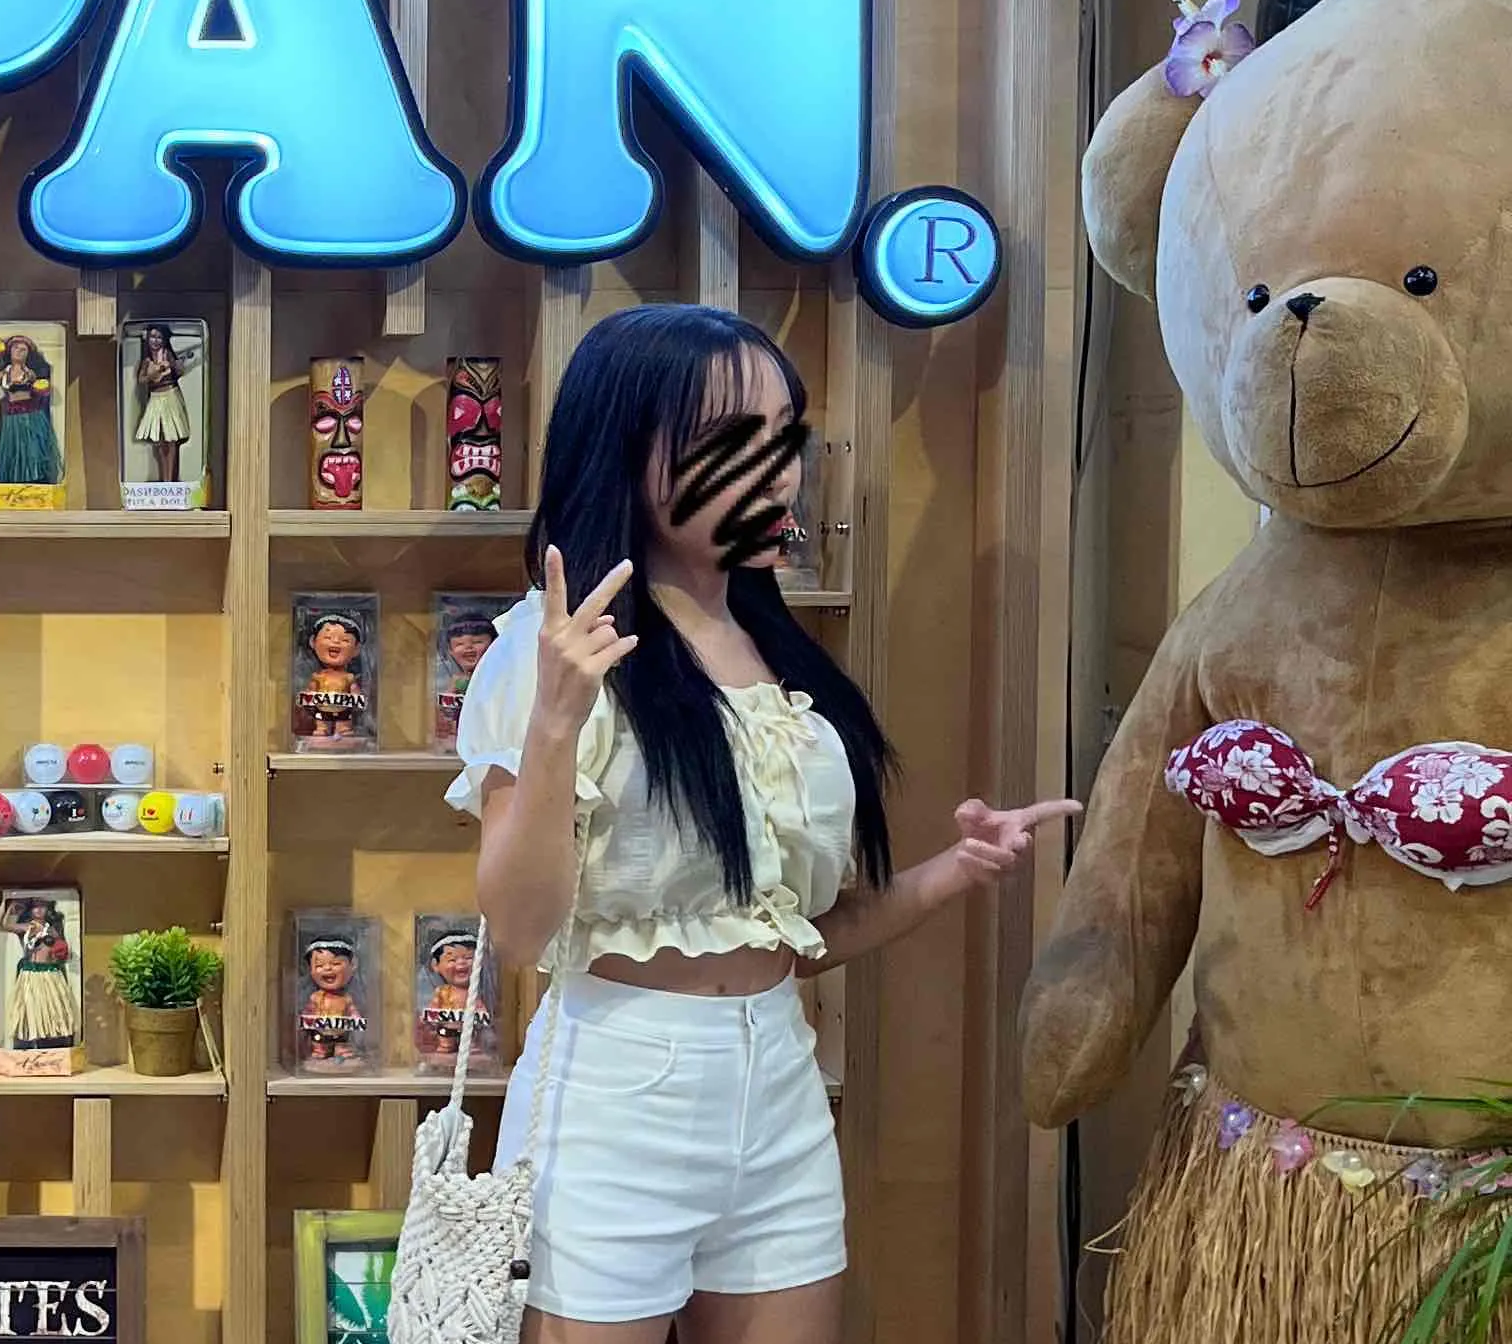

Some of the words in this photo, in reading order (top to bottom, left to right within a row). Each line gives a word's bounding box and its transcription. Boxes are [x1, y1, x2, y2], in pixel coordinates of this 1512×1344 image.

[313, 693, 366, 708] SAIPAN
[314, 1017, 368, 1031] SAIPAN
[439, 1009, 491, 1025] SAIAN
